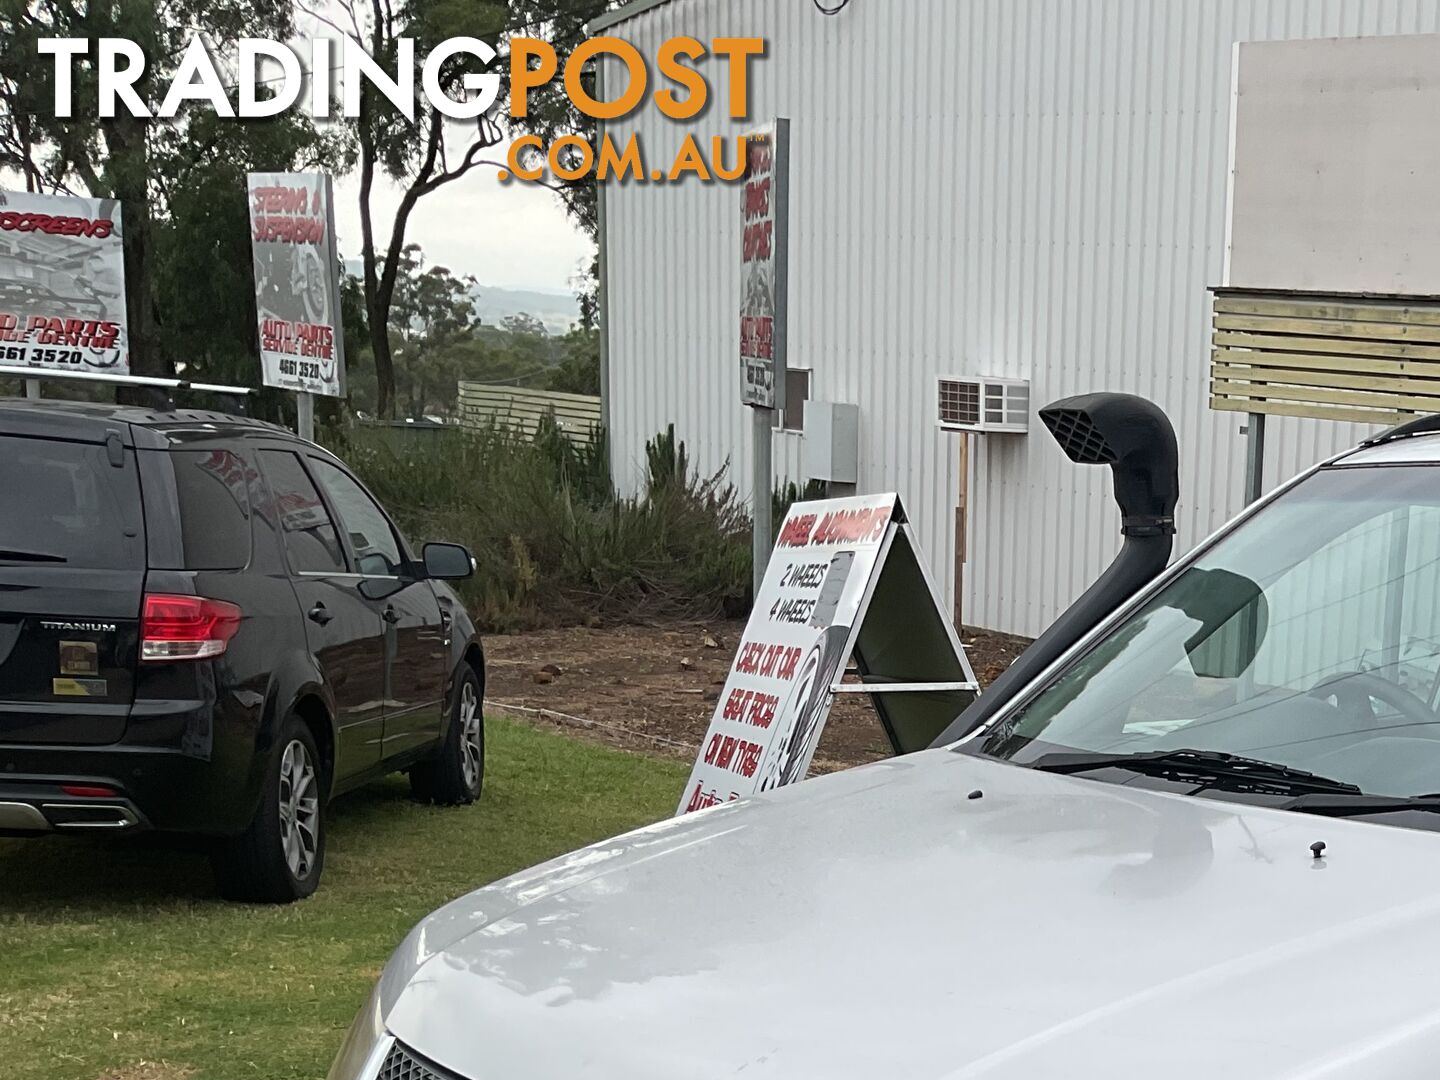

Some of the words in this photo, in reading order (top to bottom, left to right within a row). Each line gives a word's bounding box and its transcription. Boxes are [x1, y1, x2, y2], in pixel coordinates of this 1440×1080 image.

[254, 216, 325, 245] SUSPENSION
[27, 315, 120, 338] PARTS
[262, 319, 293, 341] AUTO
[296, 322, 334, 346] PARTS
[31, 348, 83, 364] 3520
[279, 359, 298, 375] 4661
[299, 361, 320, 379] 3520
[777, 514, 818, 548] WHEEL
[780, 563, 793, 587] 2
[787, 563, 829, 588] WHEELS
[769, 597, 782, 621] 4
[775, 599, 817, 624] WHEELS
[40, 621, 117, 632] TITANIUM
[735, 641, 767, 675] CHECK
[759, 644, 785, 678] OUT
[776, 647, 802, 681] OUR
[722, 688, 754, 723] GREAT
[749, 692, 780, 729] PRICES
[704, 733, 723, 764] ON
[715, 736, 741, 770] NEW
[732, 741, 764, 778] TYRES
